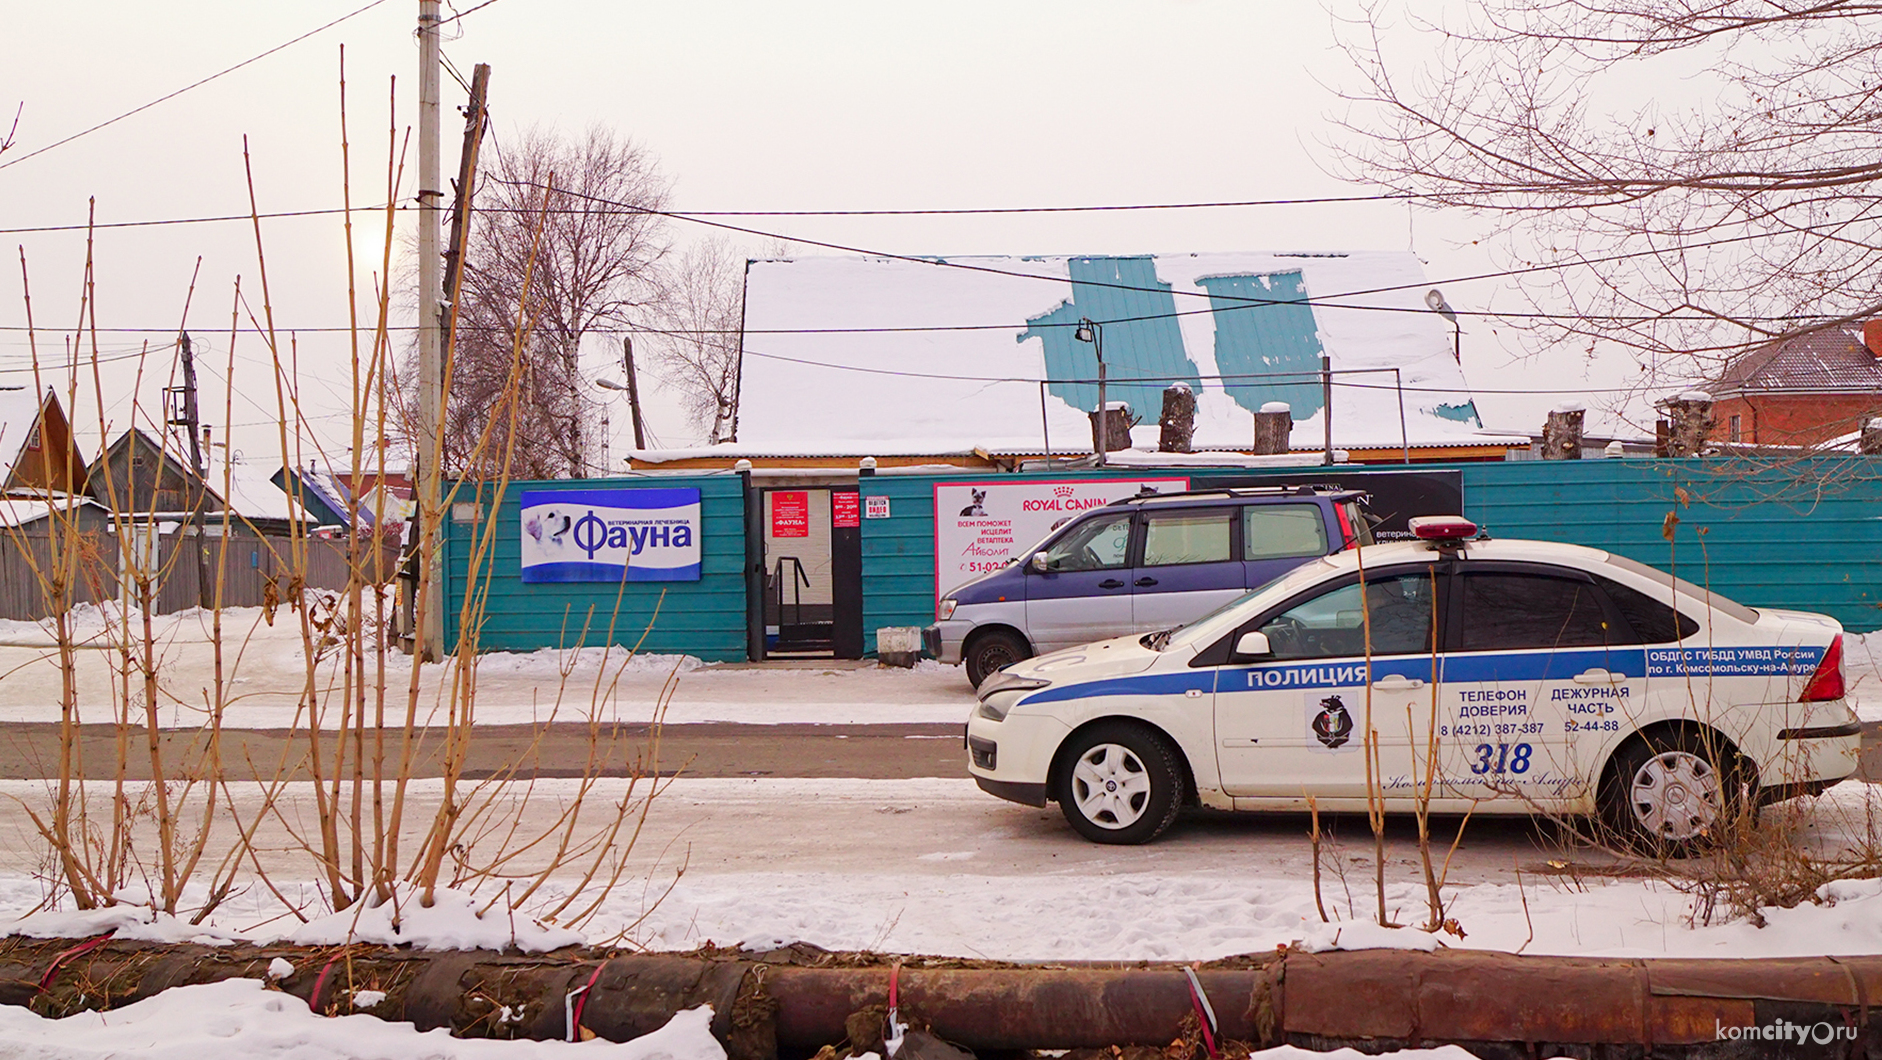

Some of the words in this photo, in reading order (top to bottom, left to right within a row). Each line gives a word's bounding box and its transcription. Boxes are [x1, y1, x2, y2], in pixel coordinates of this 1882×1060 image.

[1023, 500, 1062, 511] ROYAL
[573, 510, 692, 560] Фауна
[1650, 651, 1692, 662] ОБДПС
[1695, 650, 1736, 662] ГИБДД
[1738, 649, 1771, 661] УМВД
[1247, 666, 1367, 687] ПОЛИЦИЯ
[1459, 690, 1527, 702] ТЕЛЕФОН
[1551, 687, 1630, 701] ДЕЖУРНАЯ
[1459, 705, 1527, 718] ДОВЕРИЯ
[1568, 703, 1614, 713] ЧАСТЬ
[1441, 725, 1448, 736] 8
[1452, 724, 1491, 737] (4212)
[1495, 723, 1544, 735] 387-387
[1564, 720, 1619, 732] 52-44-88
[1471, 743, 1532, 774] 318
